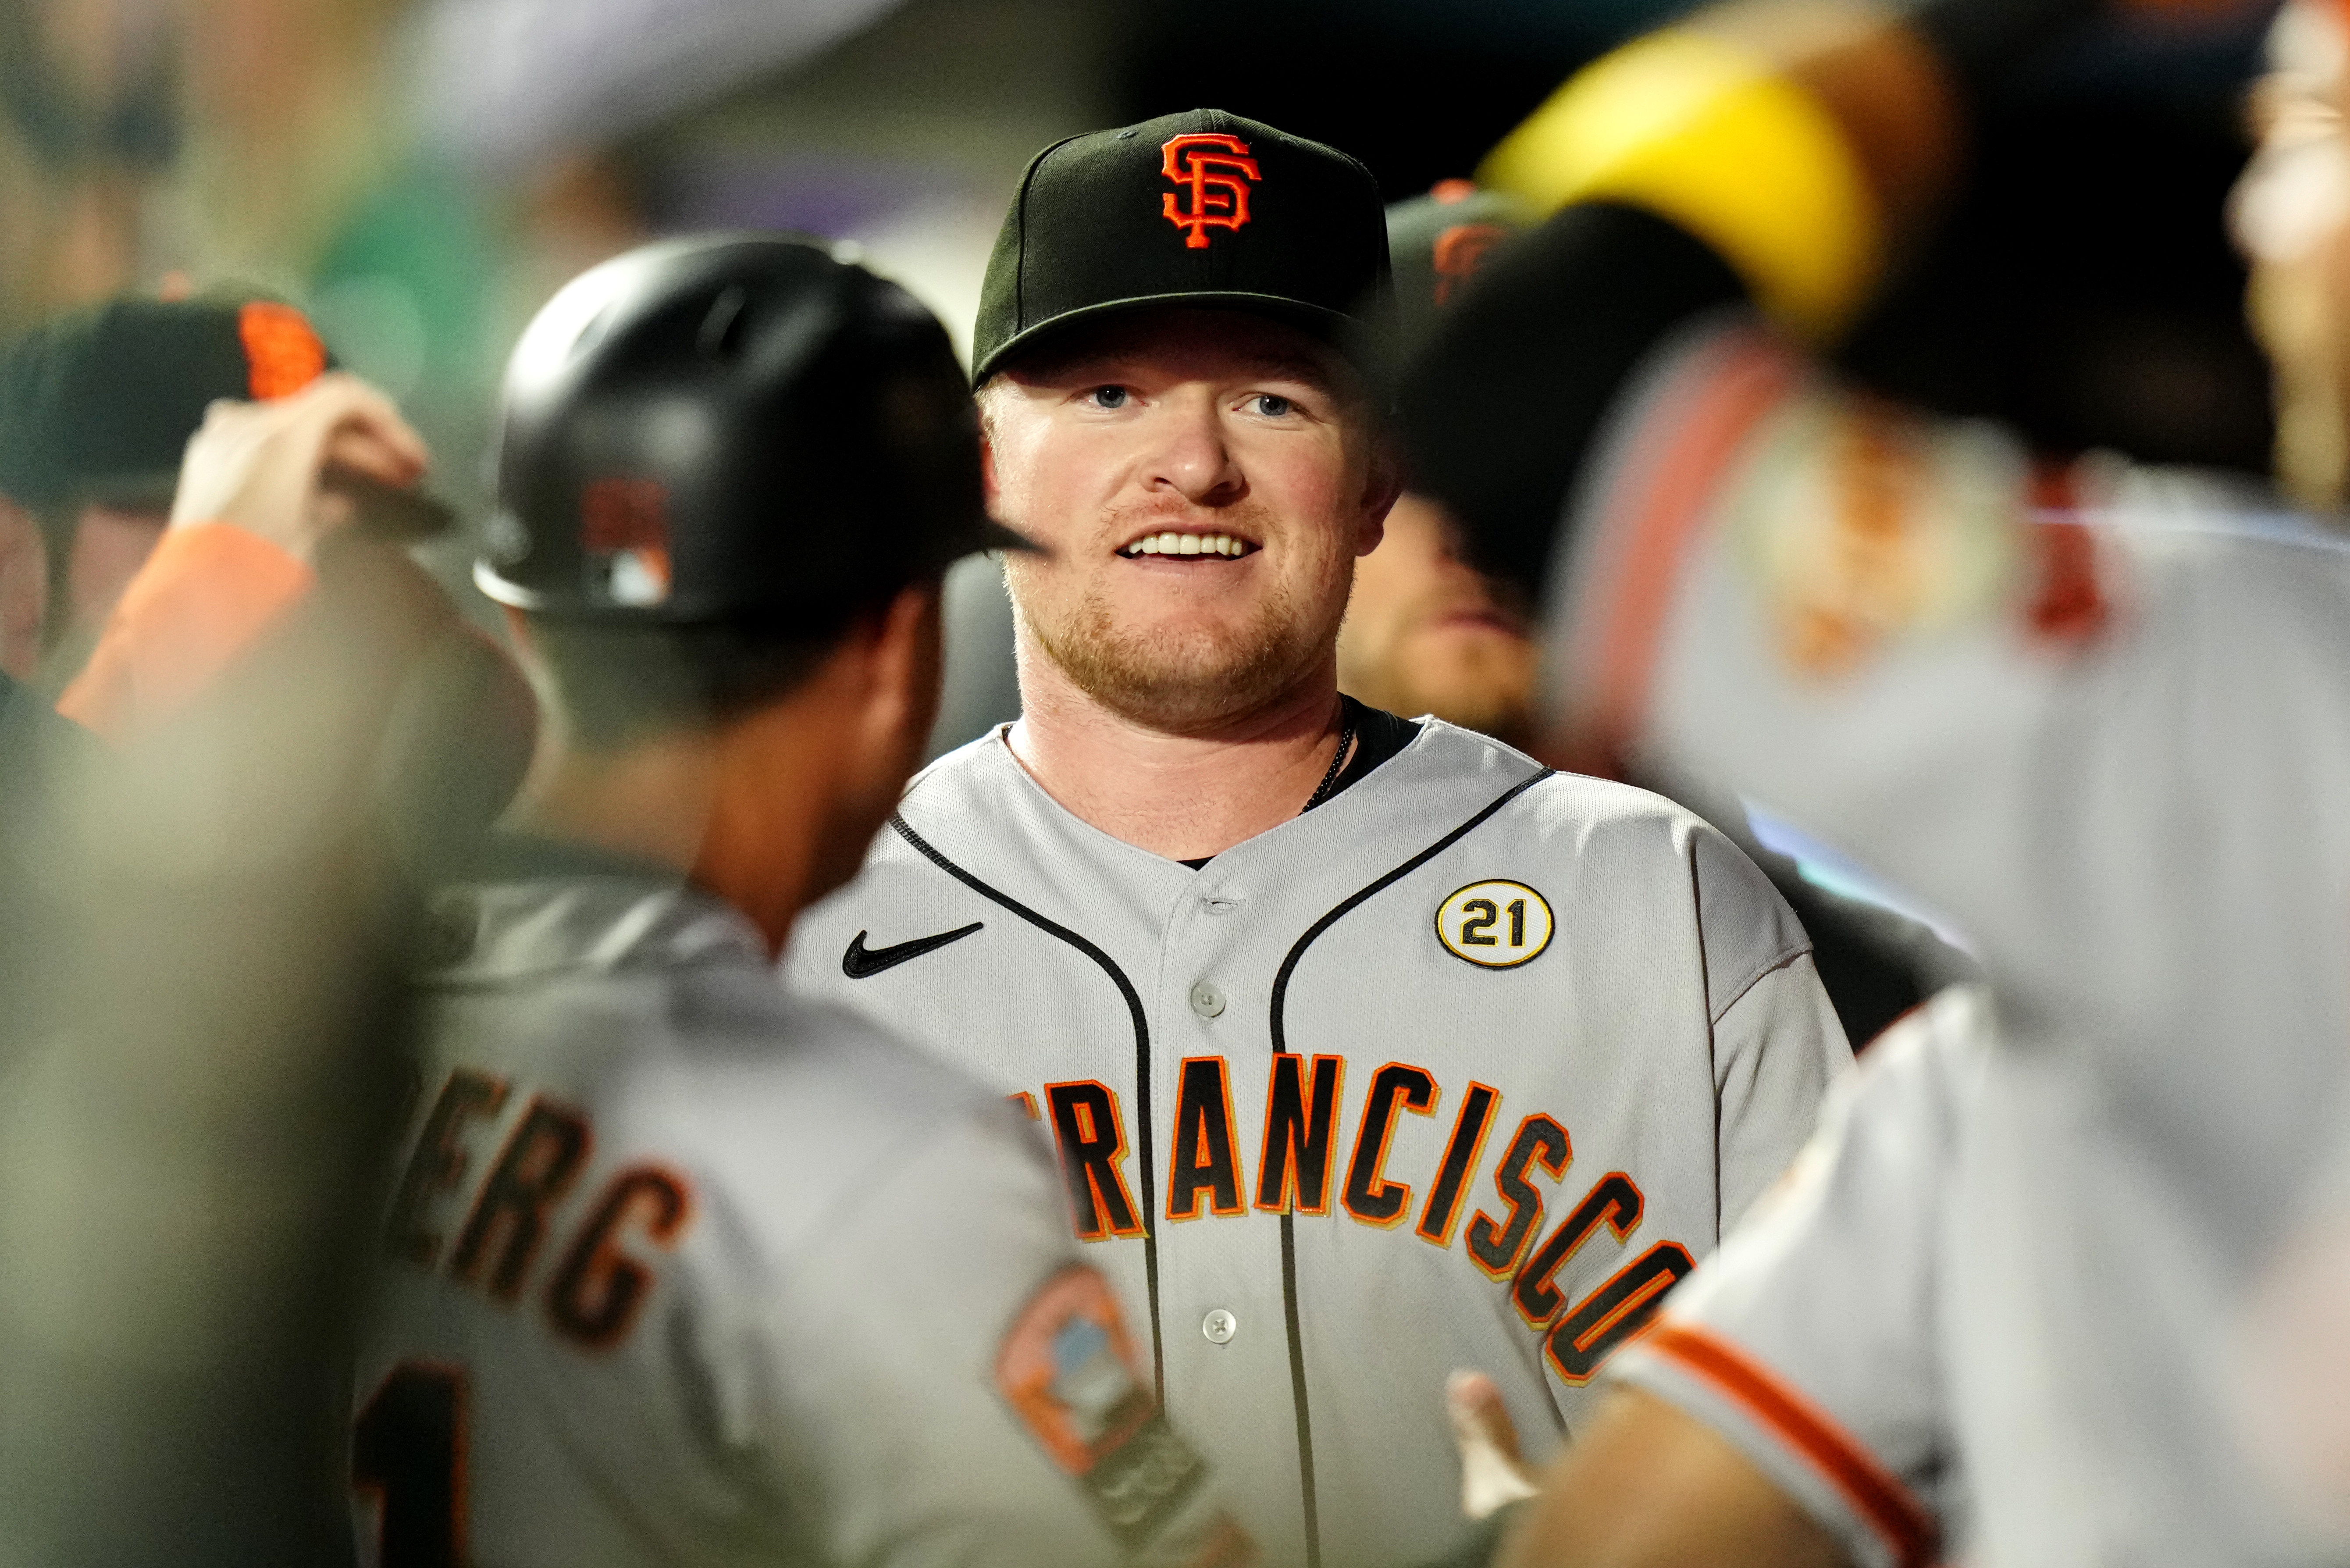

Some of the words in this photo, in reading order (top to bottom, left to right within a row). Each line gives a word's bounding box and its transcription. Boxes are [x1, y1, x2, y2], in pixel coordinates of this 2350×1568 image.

[1161, 133, 1262, 249] SF
[1460, 898, 1526, 948] 21
[382, 1066, 692, 1353] ERG
[1006, 1052, 1698, 1387] RANCISCO
